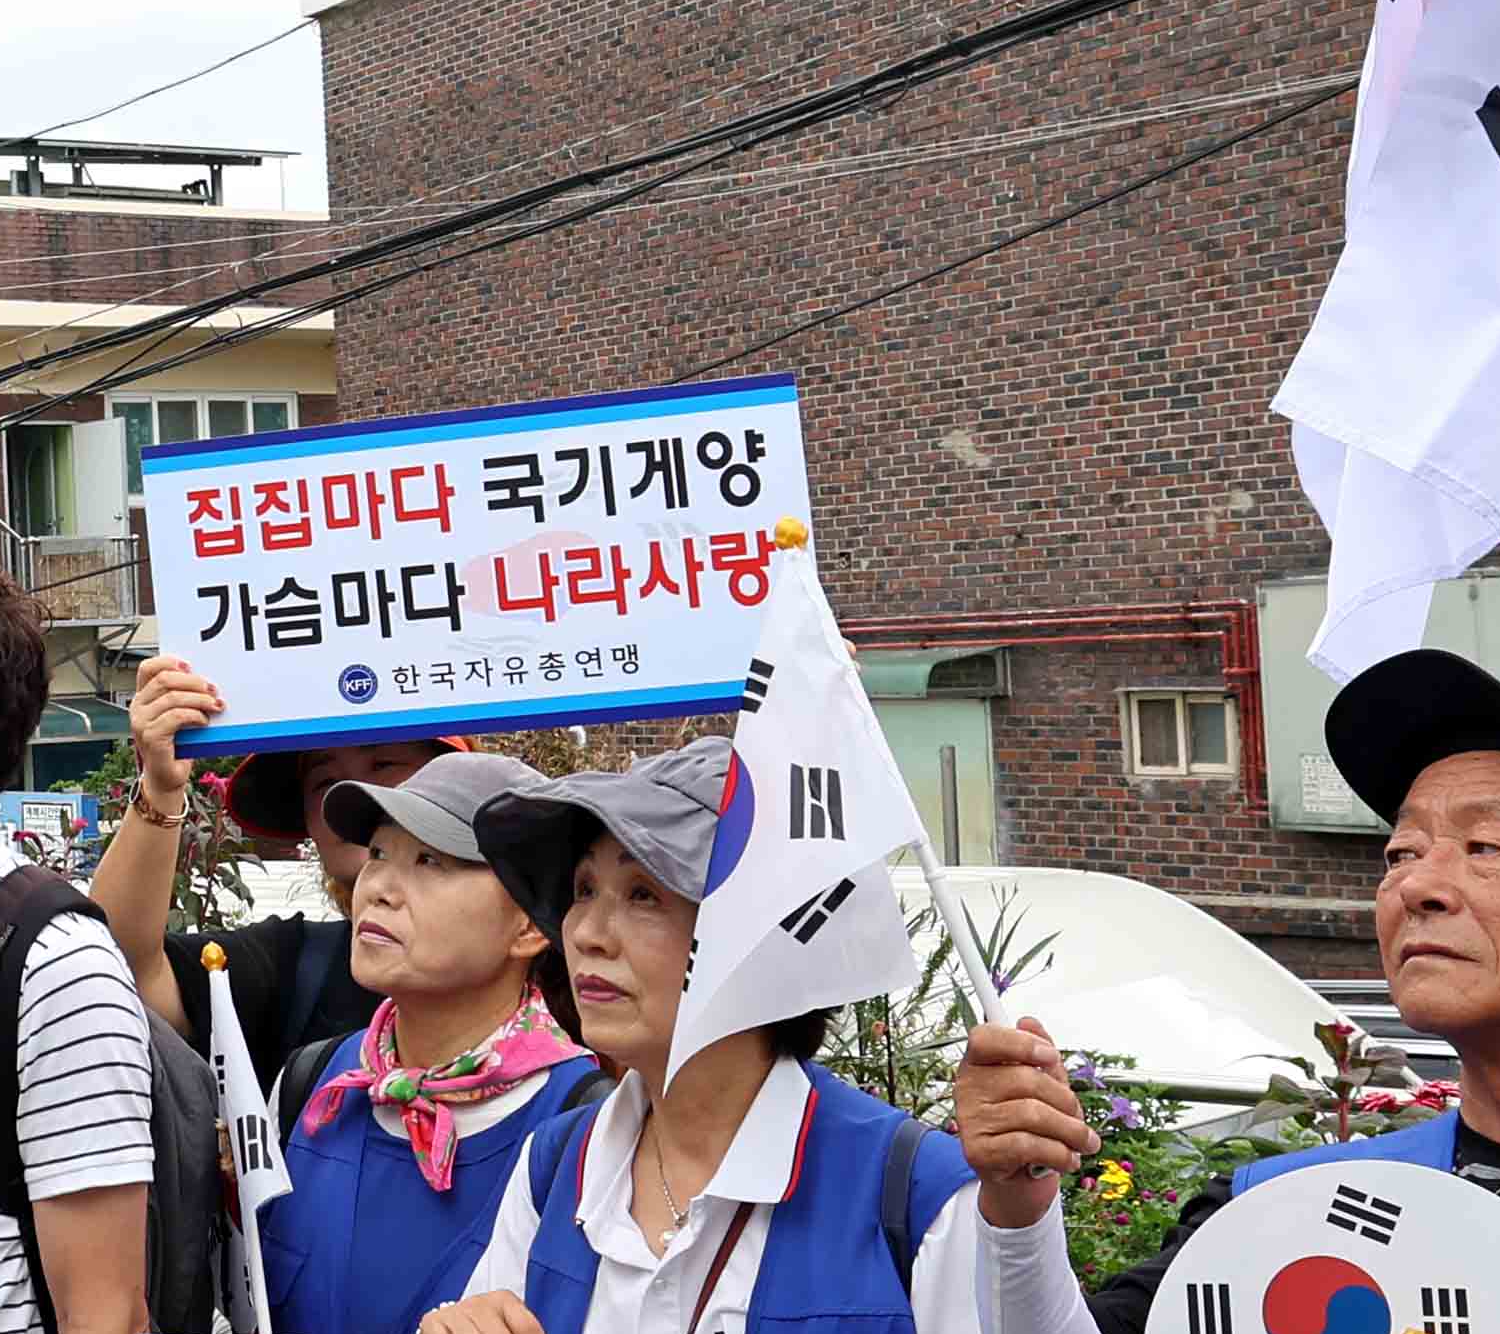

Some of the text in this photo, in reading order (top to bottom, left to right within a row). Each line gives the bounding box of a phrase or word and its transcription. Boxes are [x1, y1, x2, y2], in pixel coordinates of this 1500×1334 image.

[187, 428, 767, 558] 집집마다 국기게양
[197, 528, 779, 652] 가슴마다 나라사랑
[345, 679, 371, 691] KFF
[391, 643, 640, 695] 한국자유총연맹
